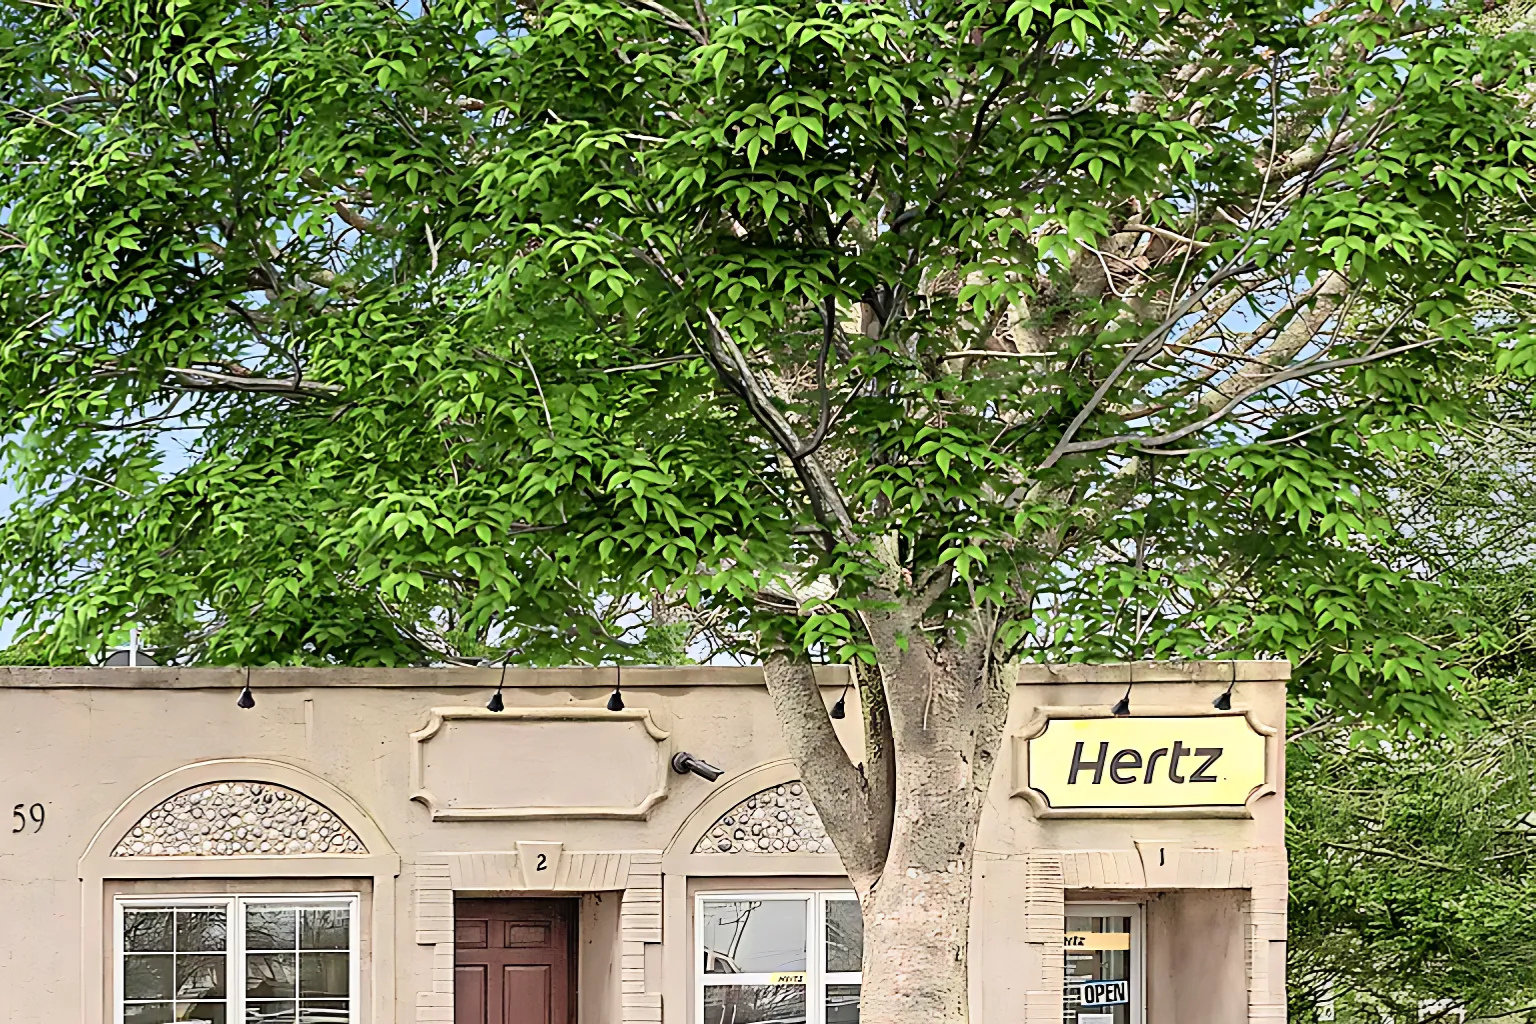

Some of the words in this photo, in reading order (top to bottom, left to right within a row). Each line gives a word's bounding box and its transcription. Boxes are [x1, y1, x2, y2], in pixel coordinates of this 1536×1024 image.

[1066, 740, 1224, 785] Hertz
[12, 802, 45, 834] 59
[536, 853, 548, 872] 2
[1159, 847, 1166, 867] 1
[1084, 982, 1126, 1004] OPEN
